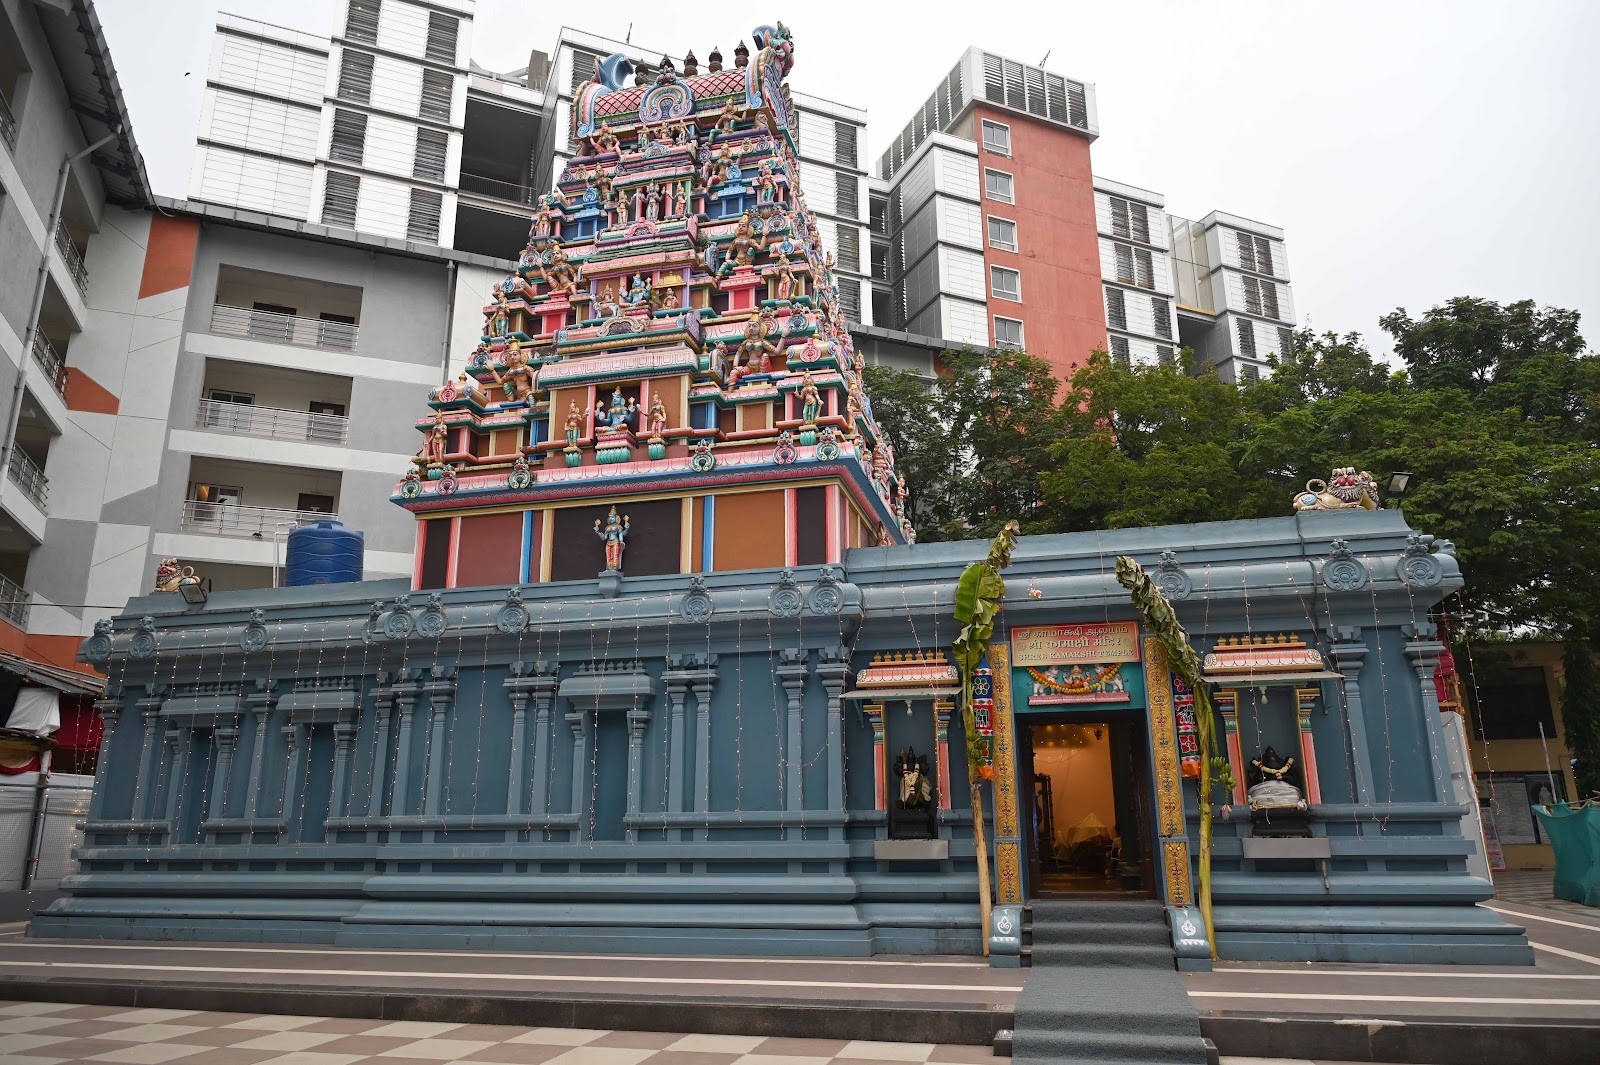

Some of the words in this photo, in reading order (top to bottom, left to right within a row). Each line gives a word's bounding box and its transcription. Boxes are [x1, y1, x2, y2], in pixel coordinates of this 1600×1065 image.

[1086, 625, 1127, 635] ஆலயம்
[1029, 639, 1042, 649] श्री
[1045, 637, 1089, 649] कामाक्षी
[1093, 635, 1120, 646] मंदिर
[1018, 653, 1047, 661] SHREE
[1049, 650, 1096, 659] KAMAKSHI
[1097, 648, 1133, 657] TEMPLE
